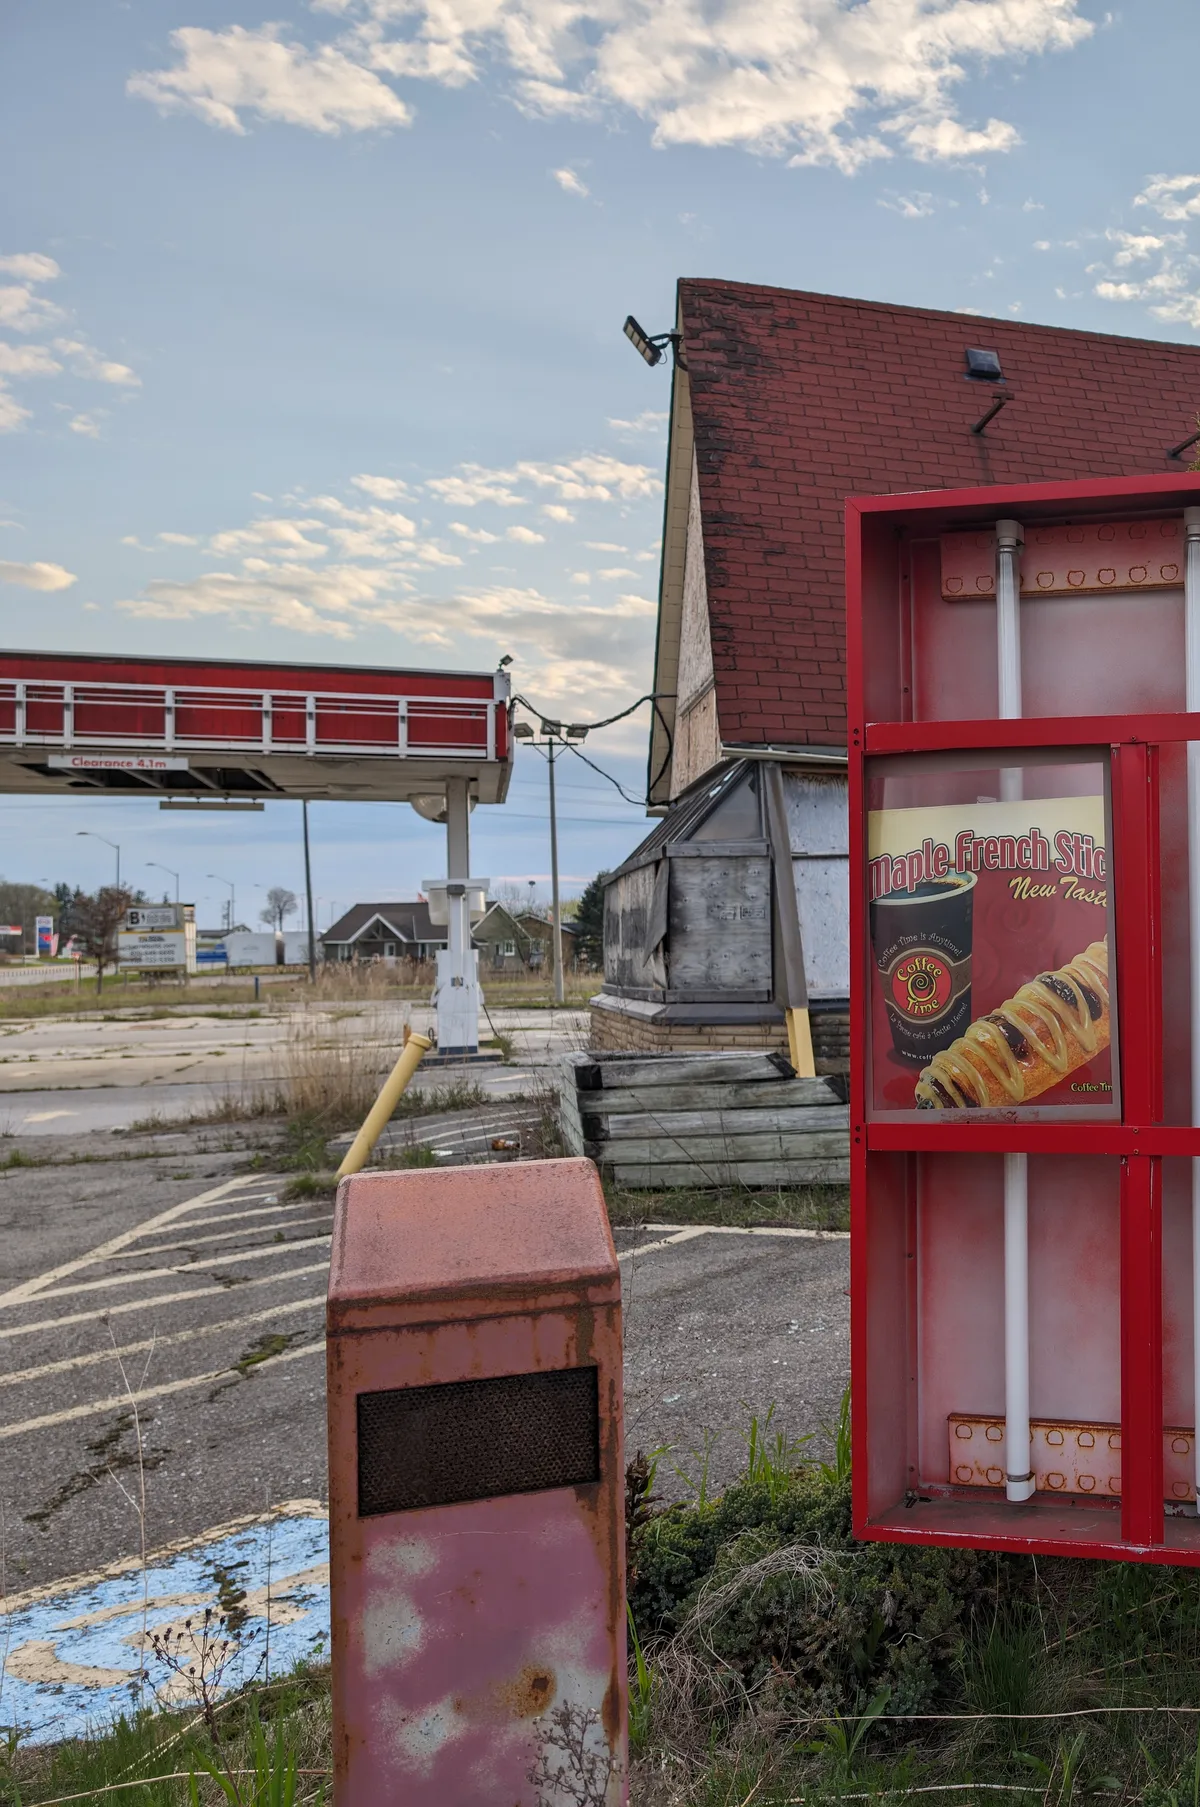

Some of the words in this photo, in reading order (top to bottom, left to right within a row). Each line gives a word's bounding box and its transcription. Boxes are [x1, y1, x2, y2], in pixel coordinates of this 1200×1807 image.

[71, 757, 133, 767] Clearance
[137, 759, 167, 768] 4.1m
[955, 828, 1049, 873] French
[1009, 876, 1058, 900] New
[878, 944, 898, 968] Coffee
[899, 933, 918, 946] Time
[920, 932, 927, 941] is
[928, 932, 963, 957] Anytime!
[897, 957, 942, 981] Coffee
[907, 996, 940, 1014] Time
[1070, 1082, 1099, 1092] Coffee
